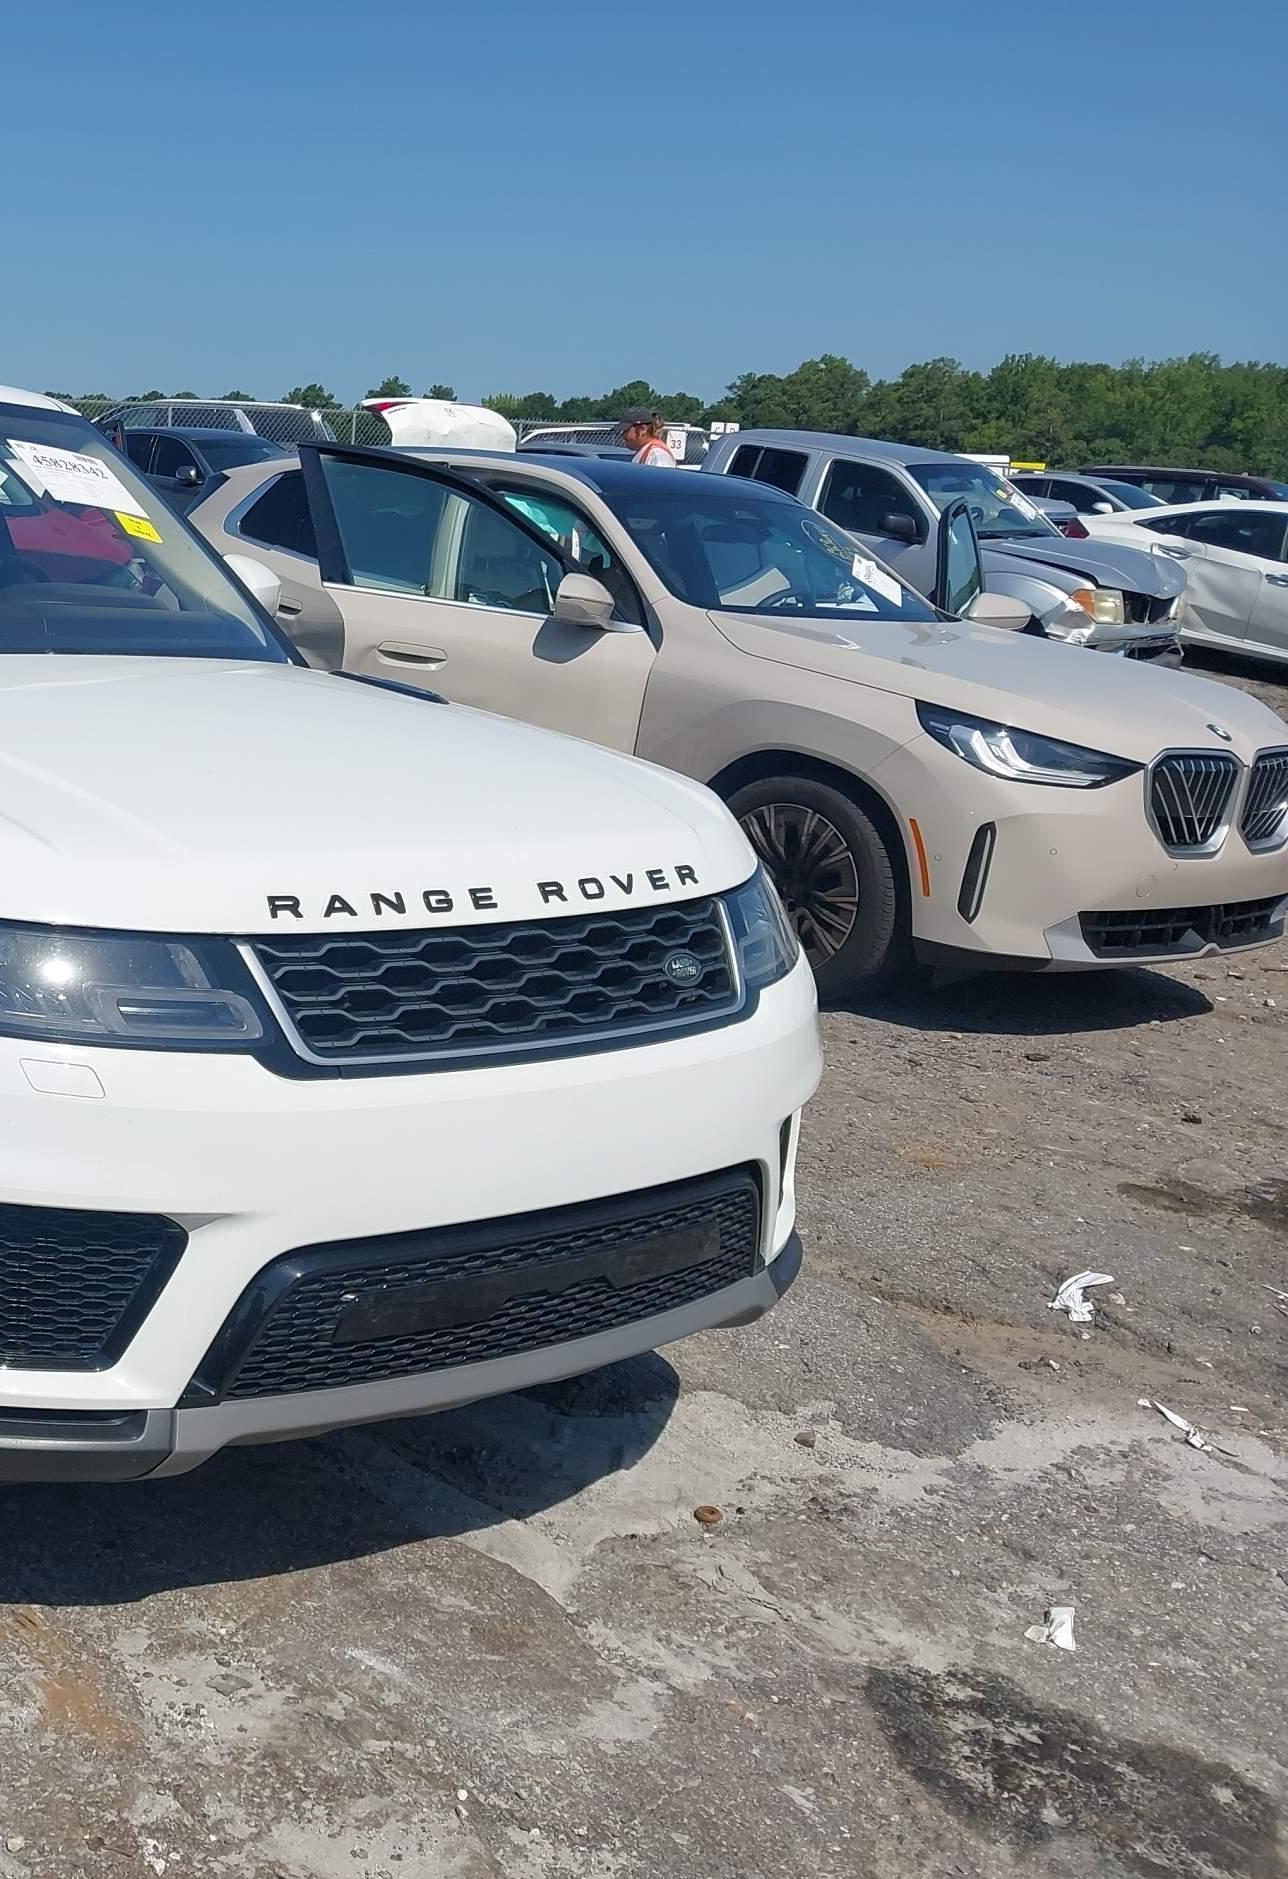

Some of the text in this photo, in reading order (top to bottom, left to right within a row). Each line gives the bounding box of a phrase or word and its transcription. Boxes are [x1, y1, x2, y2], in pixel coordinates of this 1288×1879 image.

[670, 439, 682, 450] 33
[32, 455, 109, 480] 45828342
[266, 864, 700, 919] RANGE ROVER
